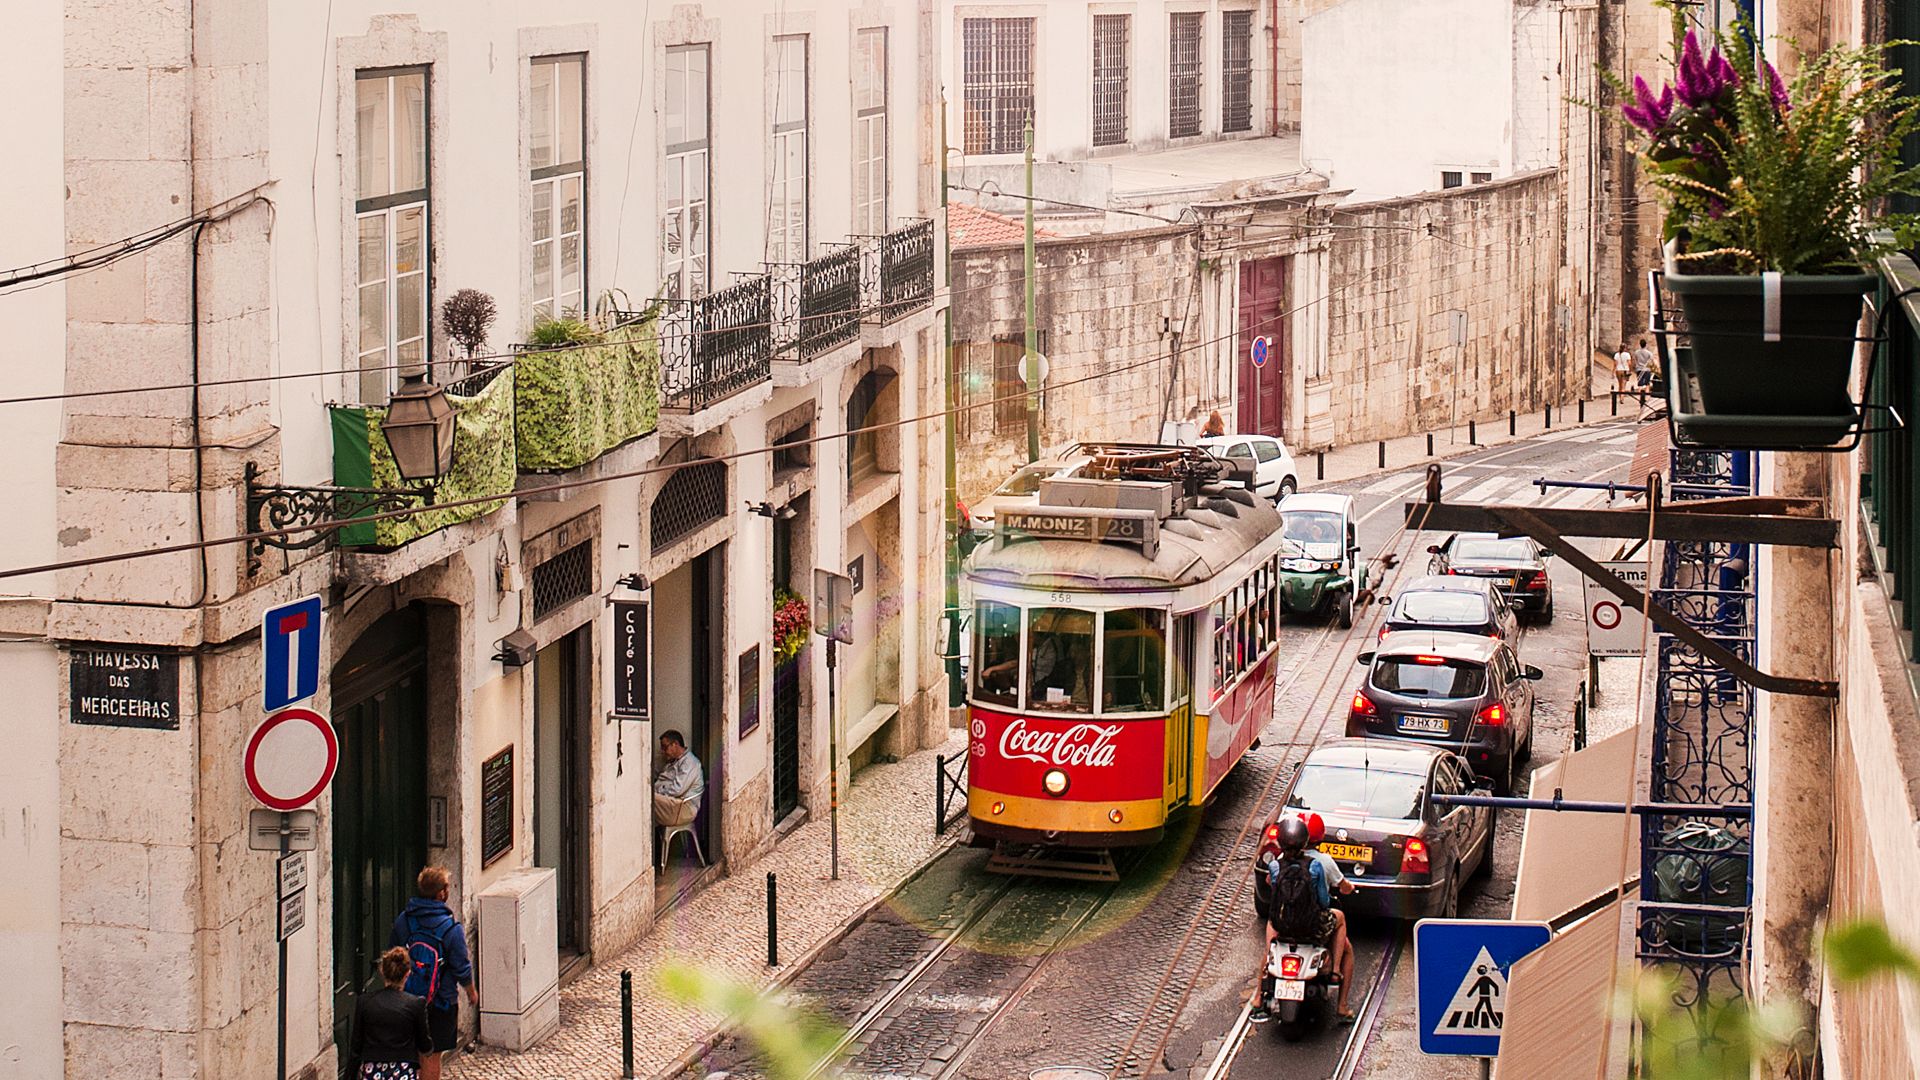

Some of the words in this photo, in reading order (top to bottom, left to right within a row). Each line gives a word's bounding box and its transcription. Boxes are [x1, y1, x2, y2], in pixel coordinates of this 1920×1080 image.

[1007, 515, 1085, 531] M.MONIZ
[1106, 519, 1134, 536] 28
[1608, 568, 1647, 581] fama
[1051, 593, 1072, 603] 558
[626, 610, 635, 658] Café
[88, 652, 160, 670] TRAVESSA
[109, 675, 130, 688] DAS
[81, 697, 170, 719] MERCEEIRAS
[999, 719, 1124, 767] Coca-Cola
[1348, 846, 1370, 858] KMF
